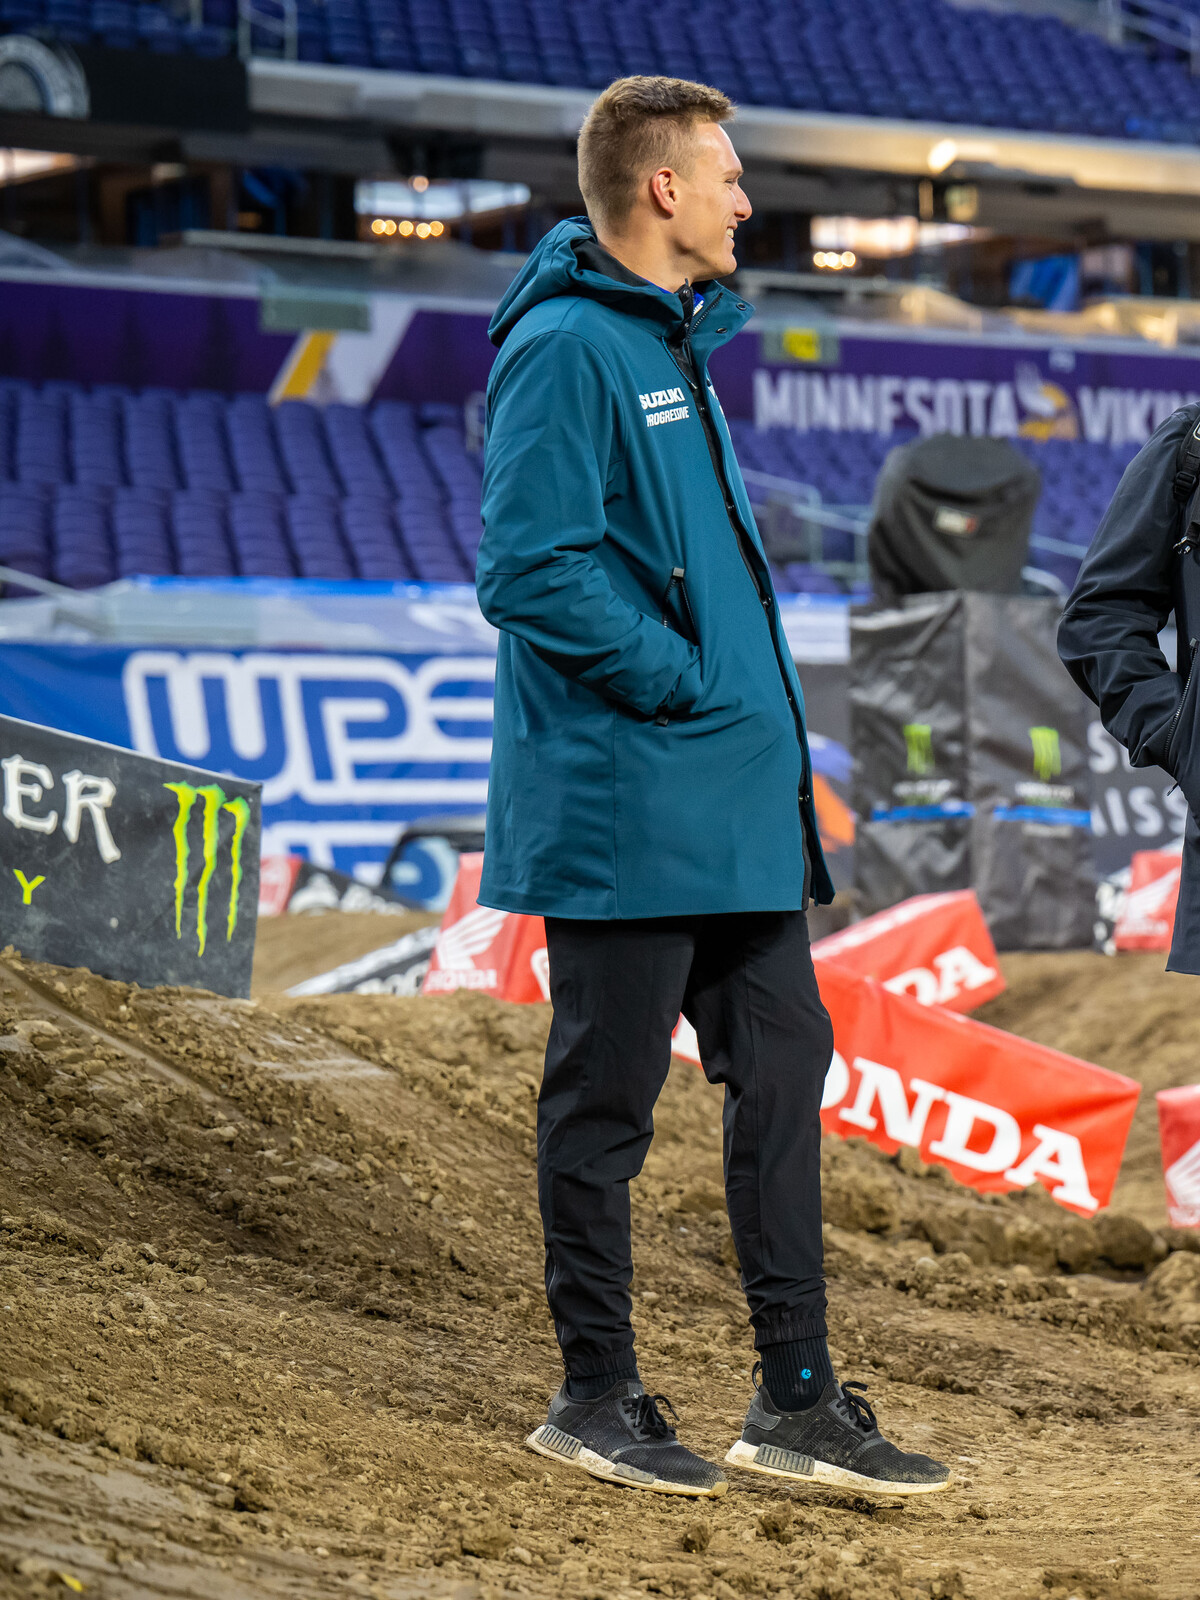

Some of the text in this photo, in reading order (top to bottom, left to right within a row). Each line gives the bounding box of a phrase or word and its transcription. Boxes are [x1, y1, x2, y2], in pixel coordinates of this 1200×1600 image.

[639, 387, 685, 410] SUZUKI
[646, 406, 690, 427] PROGRESSIVE
[752, 369, 1018, 440] MINNESOTA
[2, 754, 121, 864] ER
